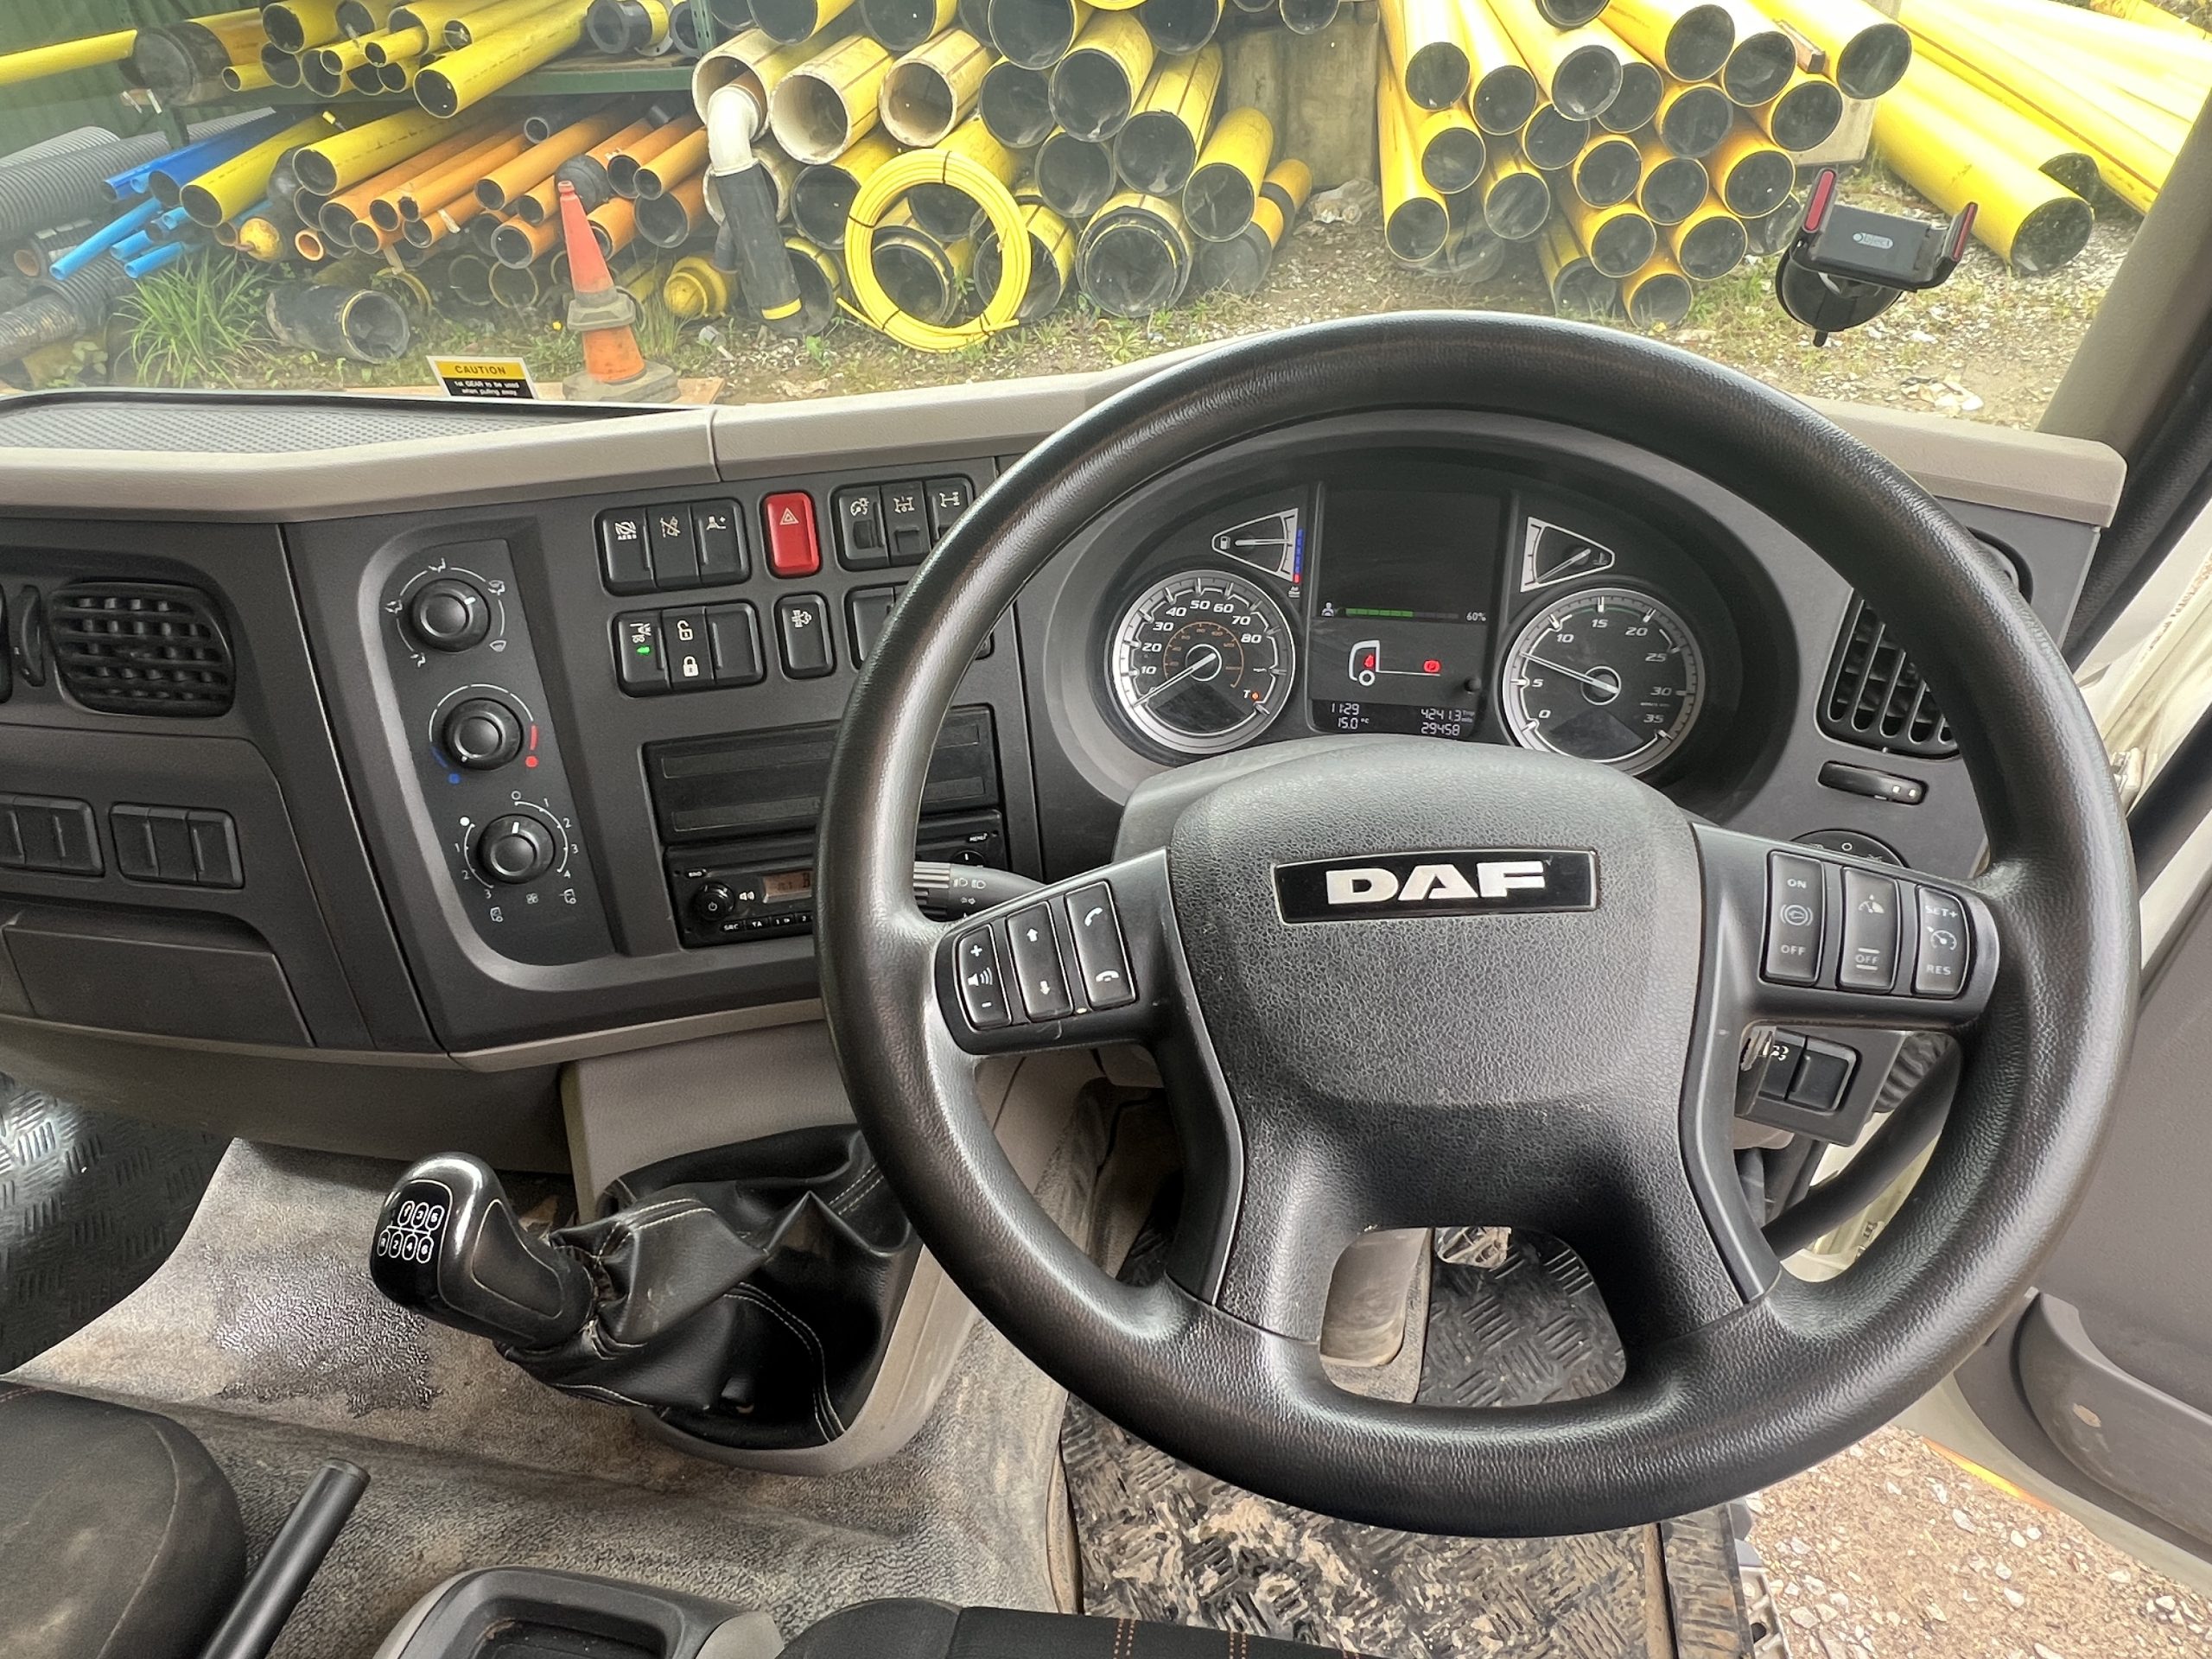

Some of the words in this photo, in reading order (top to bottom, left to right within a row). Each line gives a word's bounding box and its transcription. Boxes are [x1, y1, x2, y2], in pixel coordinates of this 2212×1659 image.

[454, 365, 506, 375] CAUTION
[1189, 600, 1211, 610] 50
[1212, 603, 1235, 614] 60
[1165, 607, 1187, 617] 40
[1465, 612, 1486, 622] 60%
[1231, 615, 1251, 626] 70
[1591, 619, 1608, 628] 15
[1152, 621, 1174, 632] 30
[1624, 627, 1648, 637] 20
[1241, 633, 1262, 644] 80
[1556, 633, 1574, 644] 10
[1141, 642, 1162, 652] 20
[1644, 652, 1667, 663] 25
[1140, 665, 1157, 675] 10
[1531, 678, 1544, 688] 5
[1650, 686, 1672, 696] 30
[1332, 702, 1360, 715] 11:29
[1538, 709, 1551, 718] 0
[1338, 717, 1358, 729] 15.0
[1643, 714, 1664, 724] 35
[1421, 721, 1460, 736] 29458
[563, 817, 572, 828] 2
[571, 843, 579, 854] 3
[461, 870, 470, 880] 2
[563, 870, 571, 879] 4
[1325, 861, 1546, 906] DAF
[1787, 878, 1807, 889] ON
[484, 889, 492, 899] 3
[1781, 944, 1806, 956] OFF
[1854, 953, 1879, 965] OFF
[1925, 964, 1952, 976] RES
[416, 1211, 423, 1220] 3
[430, 1213, 438, 1223] 5
[392, 1240, 399, 1249] 2
[407, 1243, 413, 1251] 4
[421, 1244, 429, 1255] 6
